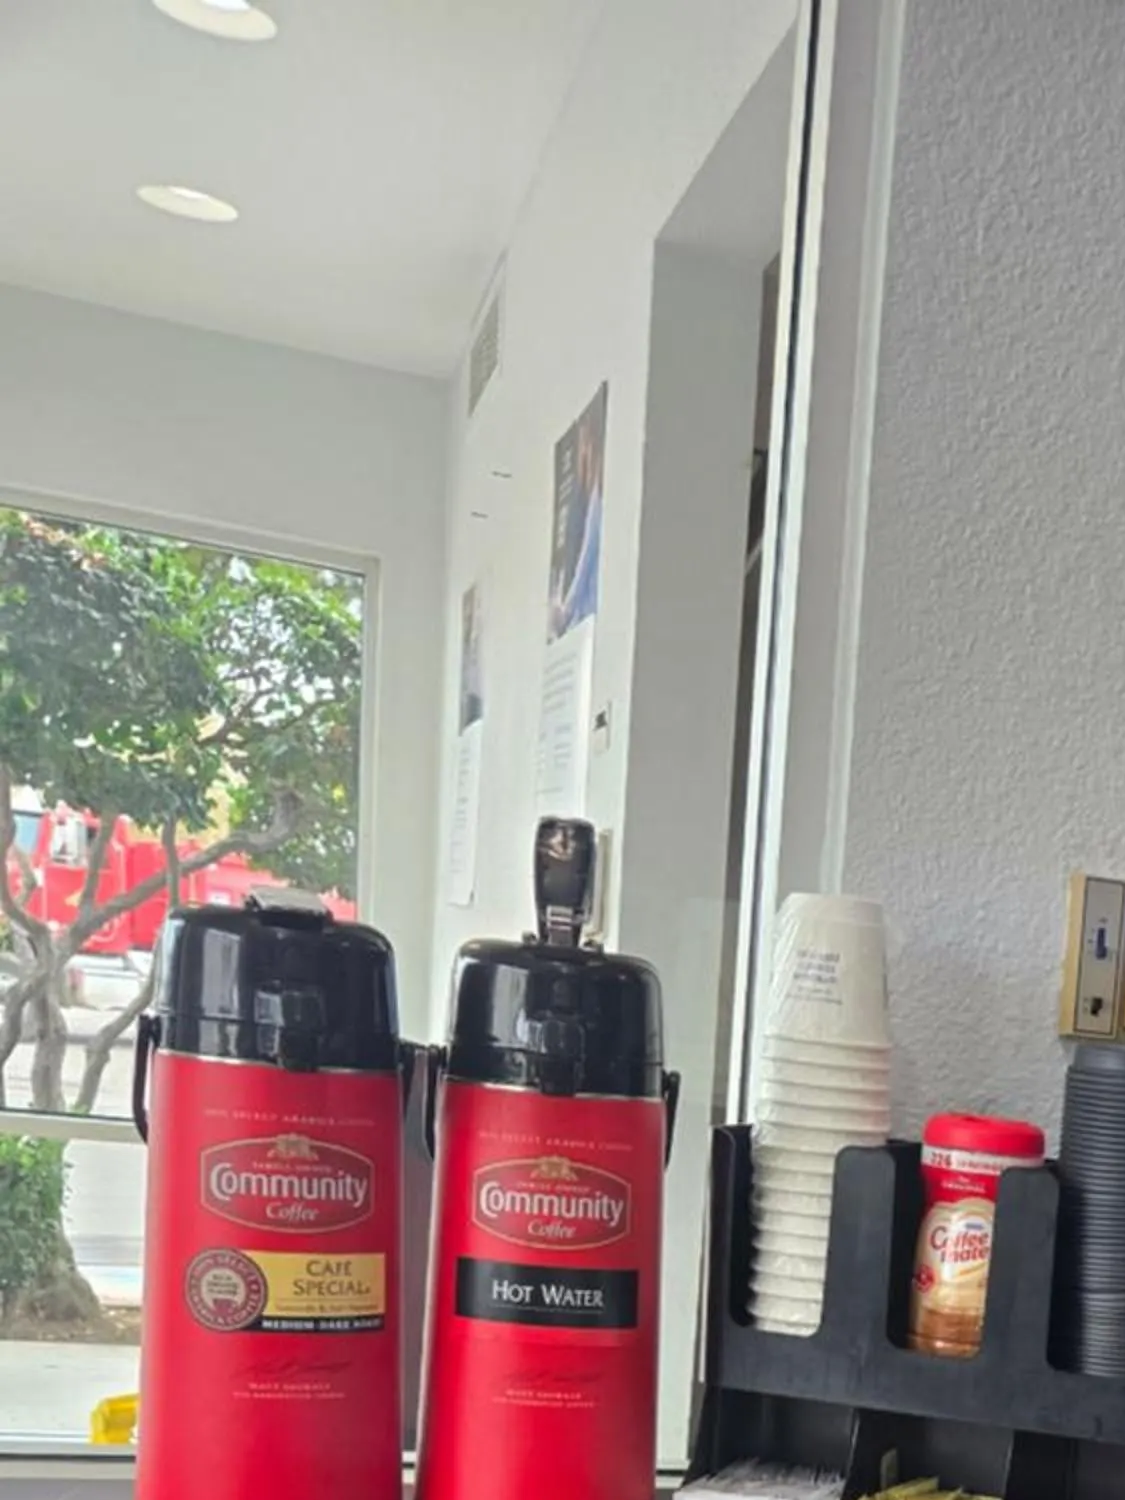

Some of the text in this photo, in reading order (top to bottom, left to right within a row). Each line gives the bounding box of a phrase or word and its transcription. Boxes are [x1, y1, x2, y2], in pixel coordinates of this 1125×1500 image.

[210, 1162, 368, 1208] Community
[265, 1201, 320, 1222] Coffee
[479, 1181, 624, 1228] Community
[527, 1218, 578, 1239] Coffee
